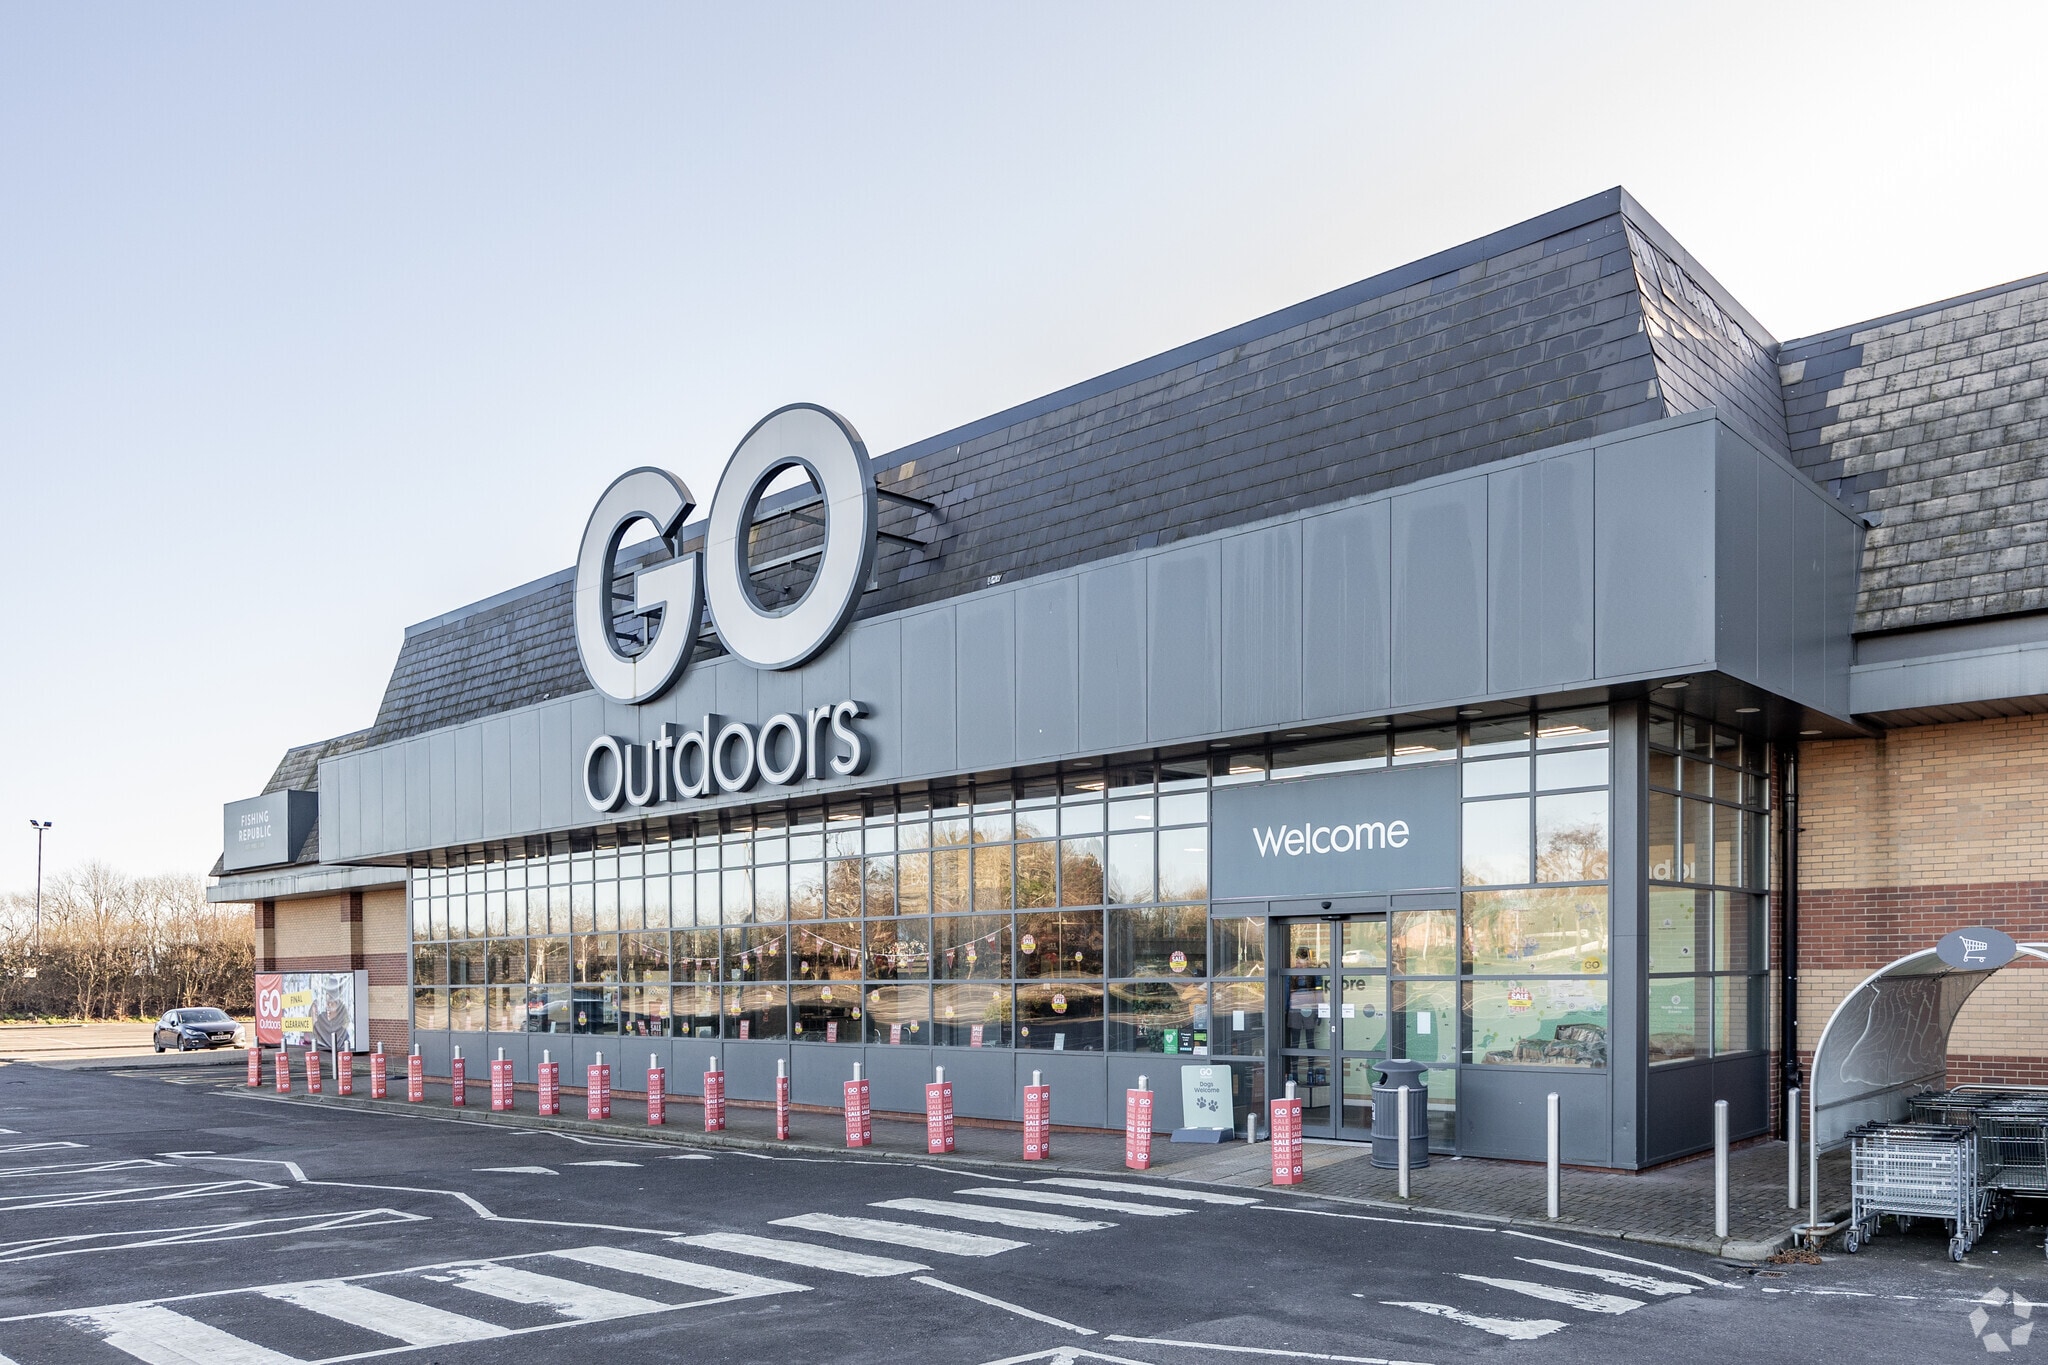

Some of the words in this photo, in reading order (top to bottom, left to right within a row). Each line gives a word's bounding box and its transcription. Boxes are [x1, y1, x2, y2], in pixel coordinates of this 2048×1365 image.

[573, 402, 877, 704] GO
[583, 700, 870, 813] Outdoors
[241, 810, 269, 827] FISHING
[238, 824, 271, 842] REPUBLIC
[1252, 820, 1409, 858] Welcome
[1585, 960, 1600, 969] GO
[259, 989, 281, 1018] GO
[290, 995, 303, 1004] FINAL
[285, 1020, 309, 1029] CLEARANCE
[651, 1024, 661, 1032] SALE
[1274, 1108, 1287, 1116] GO
